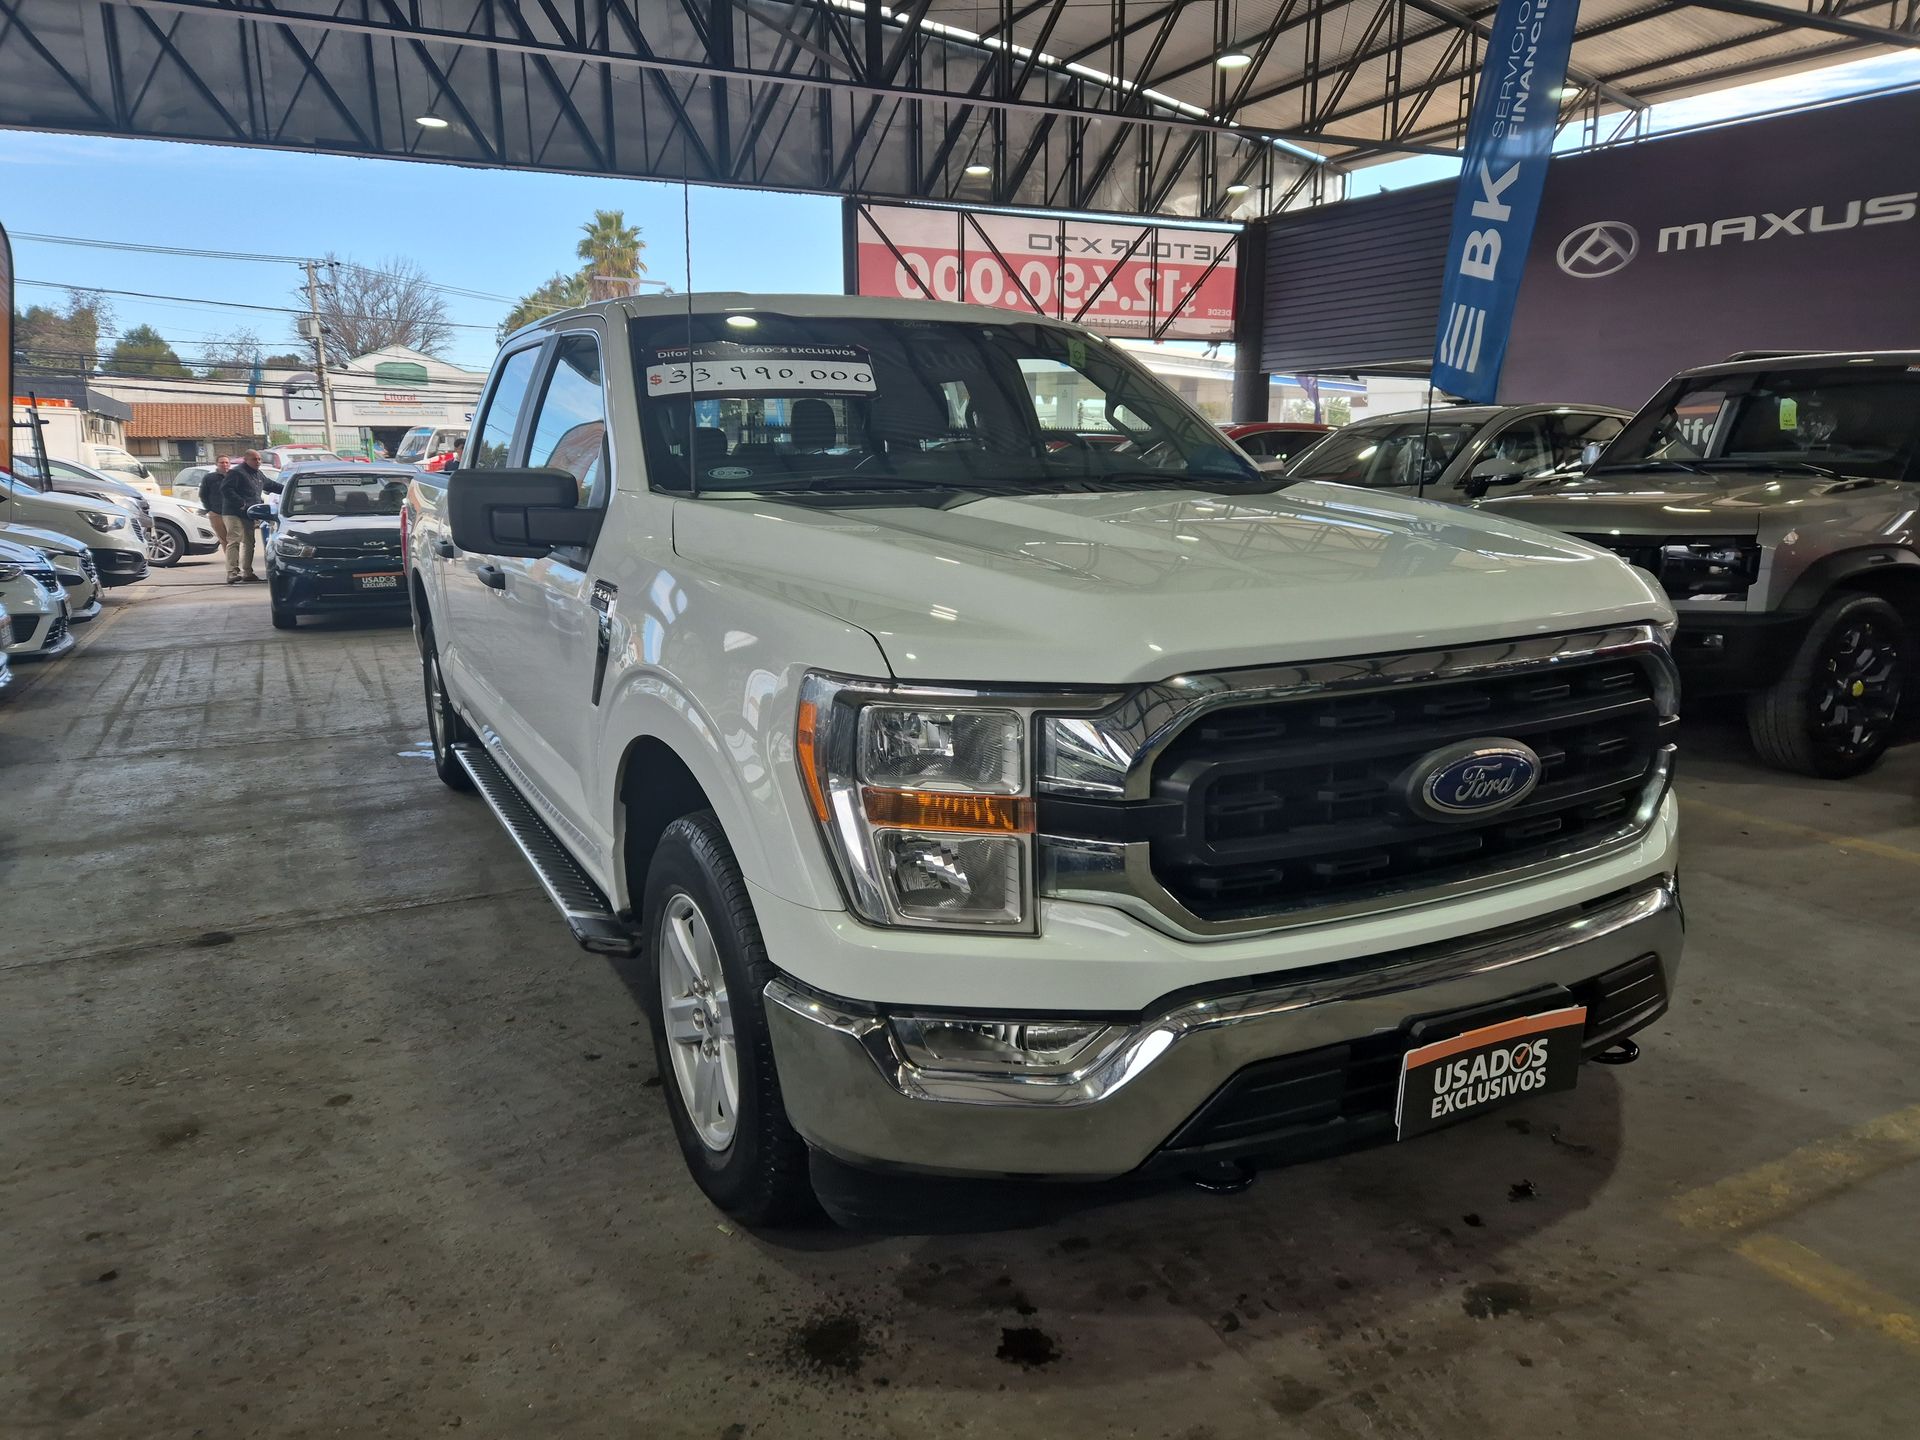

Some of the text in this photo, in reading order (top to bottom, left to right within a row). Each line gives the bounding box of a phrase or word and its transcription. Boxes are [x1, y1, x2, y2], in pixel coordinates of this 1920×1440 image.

[1492, 1, 1531, 138] SERVICIO
[1459, 157, 1520, 281] BK
[1657, 192, 1919, 252] MAXUS
[740, 347, 788, 355] USADOS
[791, 348, 857, 357] EXCLUSIVOS
[384, 393, 417, 401] Litoral
[650, 374, 663, 386] $
[361, 576, 397, 584] USADOS
[1455, 763, 1516, 802] Ford
[1434, 1038, 1549, 1095] USADOS
[1431, 1067, 1547, 1119] EXCLUSIVOS
